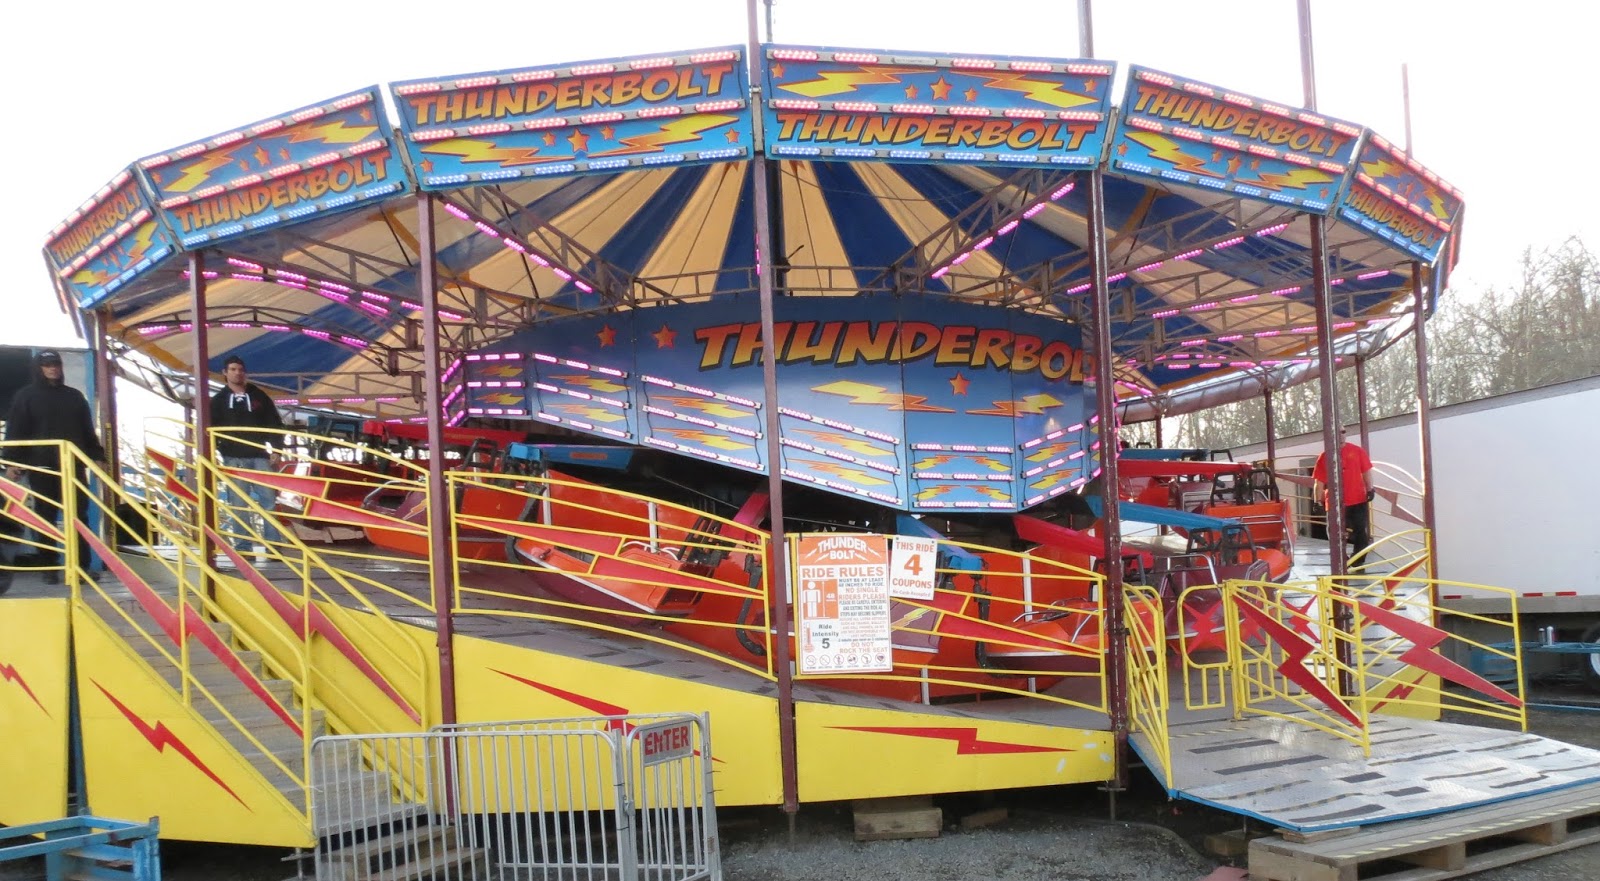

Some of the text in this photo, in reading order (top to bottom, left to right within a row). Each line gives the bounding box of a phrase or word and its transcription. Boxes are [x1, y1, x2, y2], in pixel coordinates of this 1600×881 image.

[409, 62, 734, 126] THUNDERBOLT
[776, 113, 1097, 151] THUNDERBOLT
[1133, 85, 1349, 158] THUNDERBOLT
[173, 150, 393, 233] THUNDERBOLT
[53, 179, 142, 264] THUNDERBOLT
[1345, 184, 1440, 249] THUNDERBOLT
[818, 536, 868, 554] THUNDER
[830, 550, 856, 560] BOLT
[896, 542, 934, 552] THIS RIDE
[802, 566, 884, 578] RIDE RULES
[904, 554, 922, 576] 4
[892, 578, 932, 588] COUPONS
[822, 638, 830, 649] 5
[644, 726, 690, 756] ENTER
